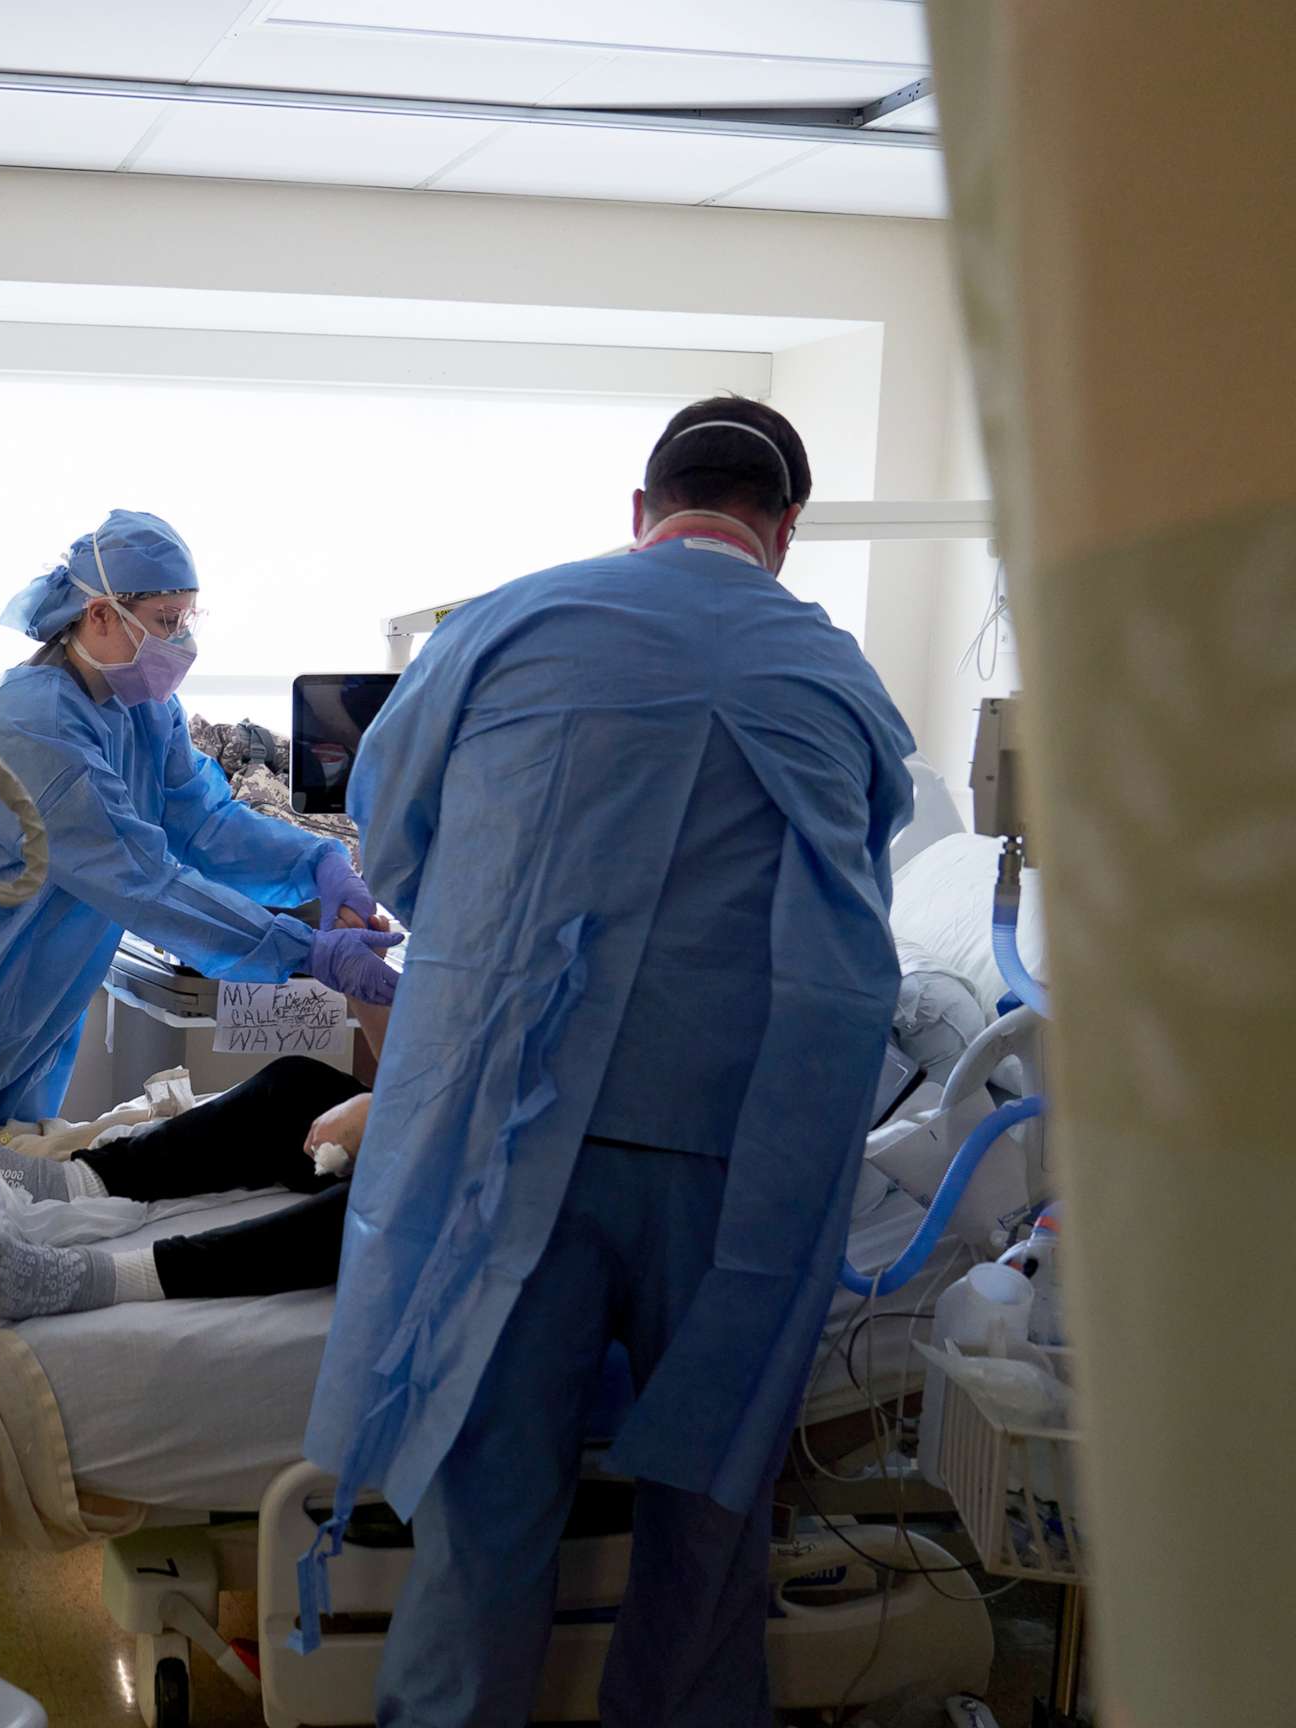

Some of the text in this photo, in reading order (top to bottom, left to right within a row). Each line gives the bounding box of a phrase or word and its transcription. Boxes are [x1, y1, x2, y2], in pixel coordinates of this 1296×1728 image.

[223, 983, 262, 1008] MY
[231, 1008, 277, 1026] CALL
[309, 1009, 341, 1026] ME
